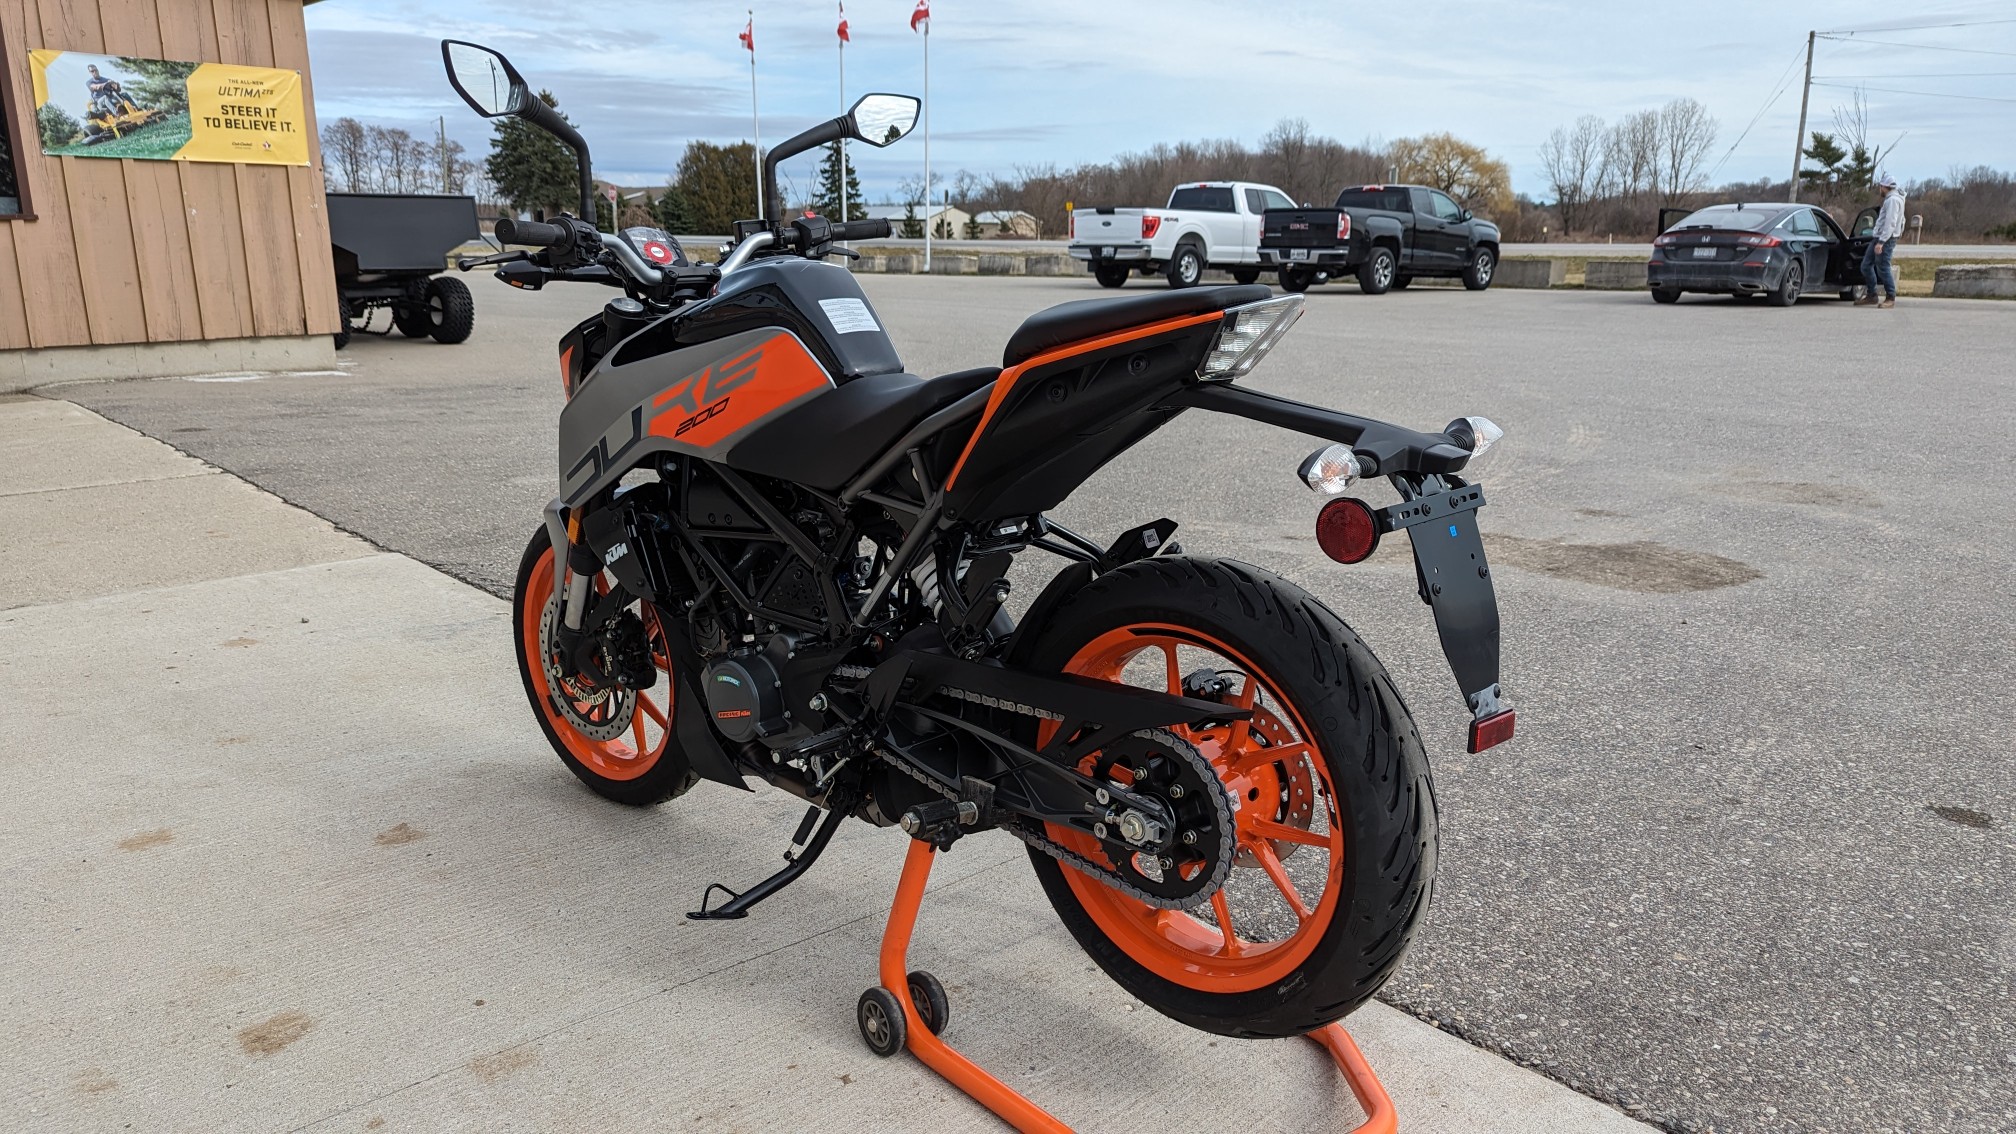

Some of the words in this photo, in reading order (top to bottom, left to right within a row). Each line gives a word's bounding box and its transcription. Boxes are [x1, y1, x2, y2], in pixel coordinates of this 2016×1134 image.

[218, 86, 261, 98] ULTIMA
[221, 104, 262, 117] STEER
[266, 107, 277, 118] IT
[203, 117, 221, 128] TO
[224, 118, 277, 131] BELIEVE
[280, 121, 296, 133] IT.
[674, 397, 730, 438] 200
[563, 350, 765, 506] DUKE
[605, 543, 628, 565] KTM
